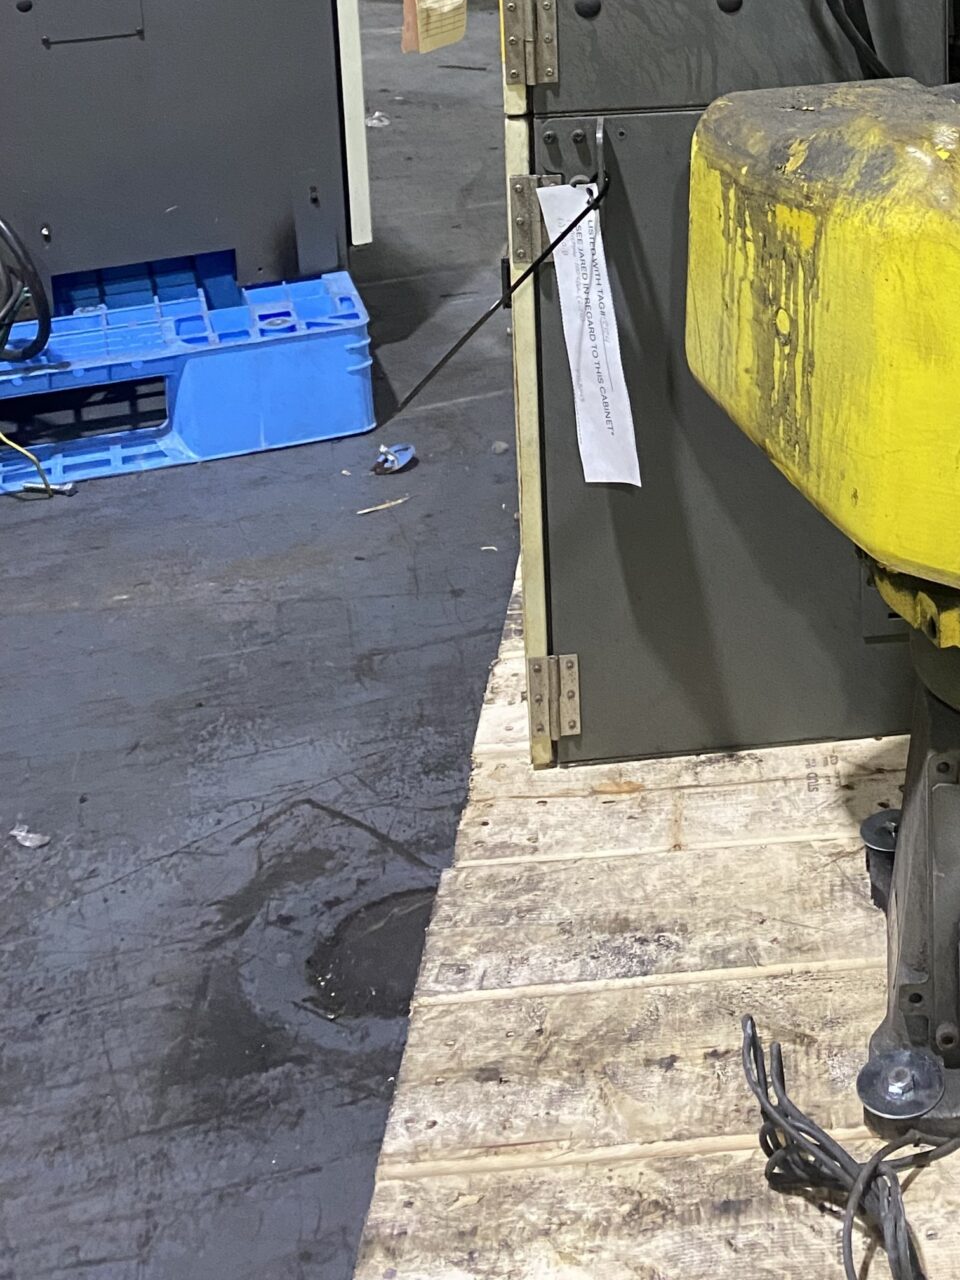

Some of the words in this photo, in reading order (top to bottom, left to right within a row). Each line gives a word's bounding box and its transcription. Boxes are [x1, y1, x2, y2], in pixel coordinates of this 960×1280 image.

[575, 224, 584, 245] SEE
[578, 247, 588, 281] JARED
[588, 219, 596, 256] LISTED
[592, 258, 602, 286] WITH
[583, 283, 591, 295] IN
[584, 297, 598, 342] REGARD
[591, 345, 600, 358] TO
[594, 360, 605, 384] THIS
